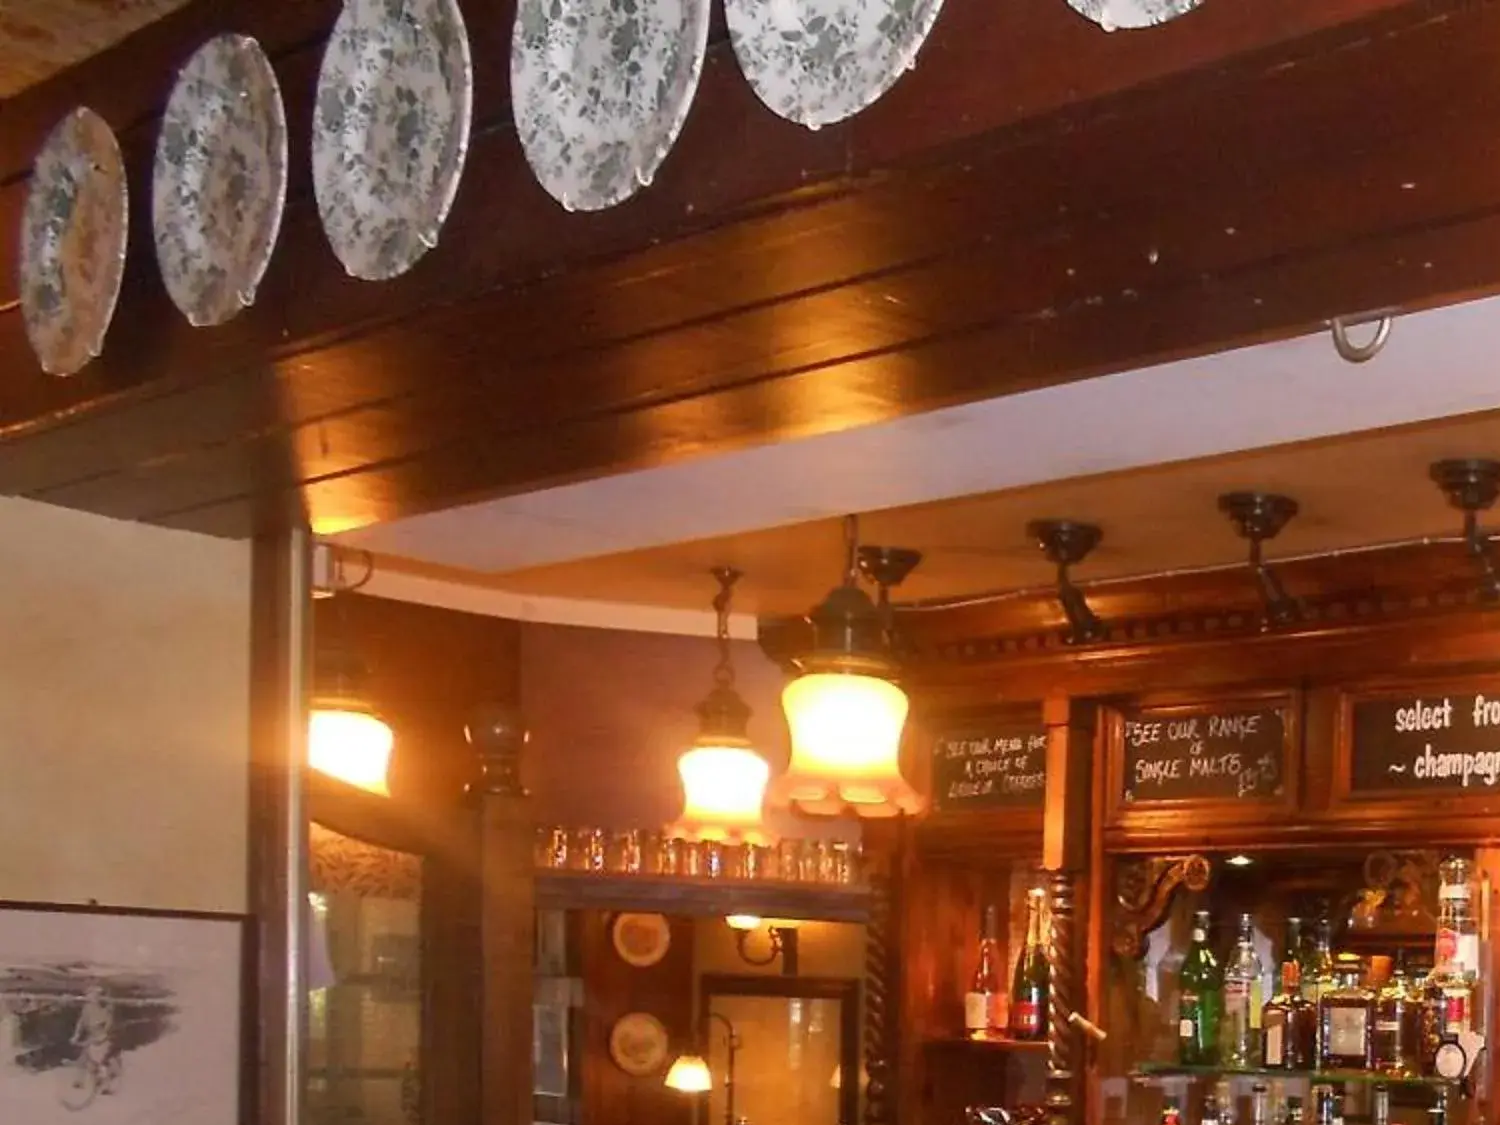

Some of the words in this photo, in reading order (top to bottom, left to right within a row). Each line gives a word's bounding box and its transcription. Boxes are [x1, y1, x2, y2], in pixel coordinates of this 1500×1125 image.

[1131, 721, 1163, 747] SEE
[1167, 717, 1200, 741] OUR
[1208, 714, 1262, 741] RANGE
[1395, 698, 1453, 733] select
[1188, 739, 1205, 756] OF
[1135, 758, 1184, 786] SINGLE
[1188, 752, 1243, 778] MALTS
